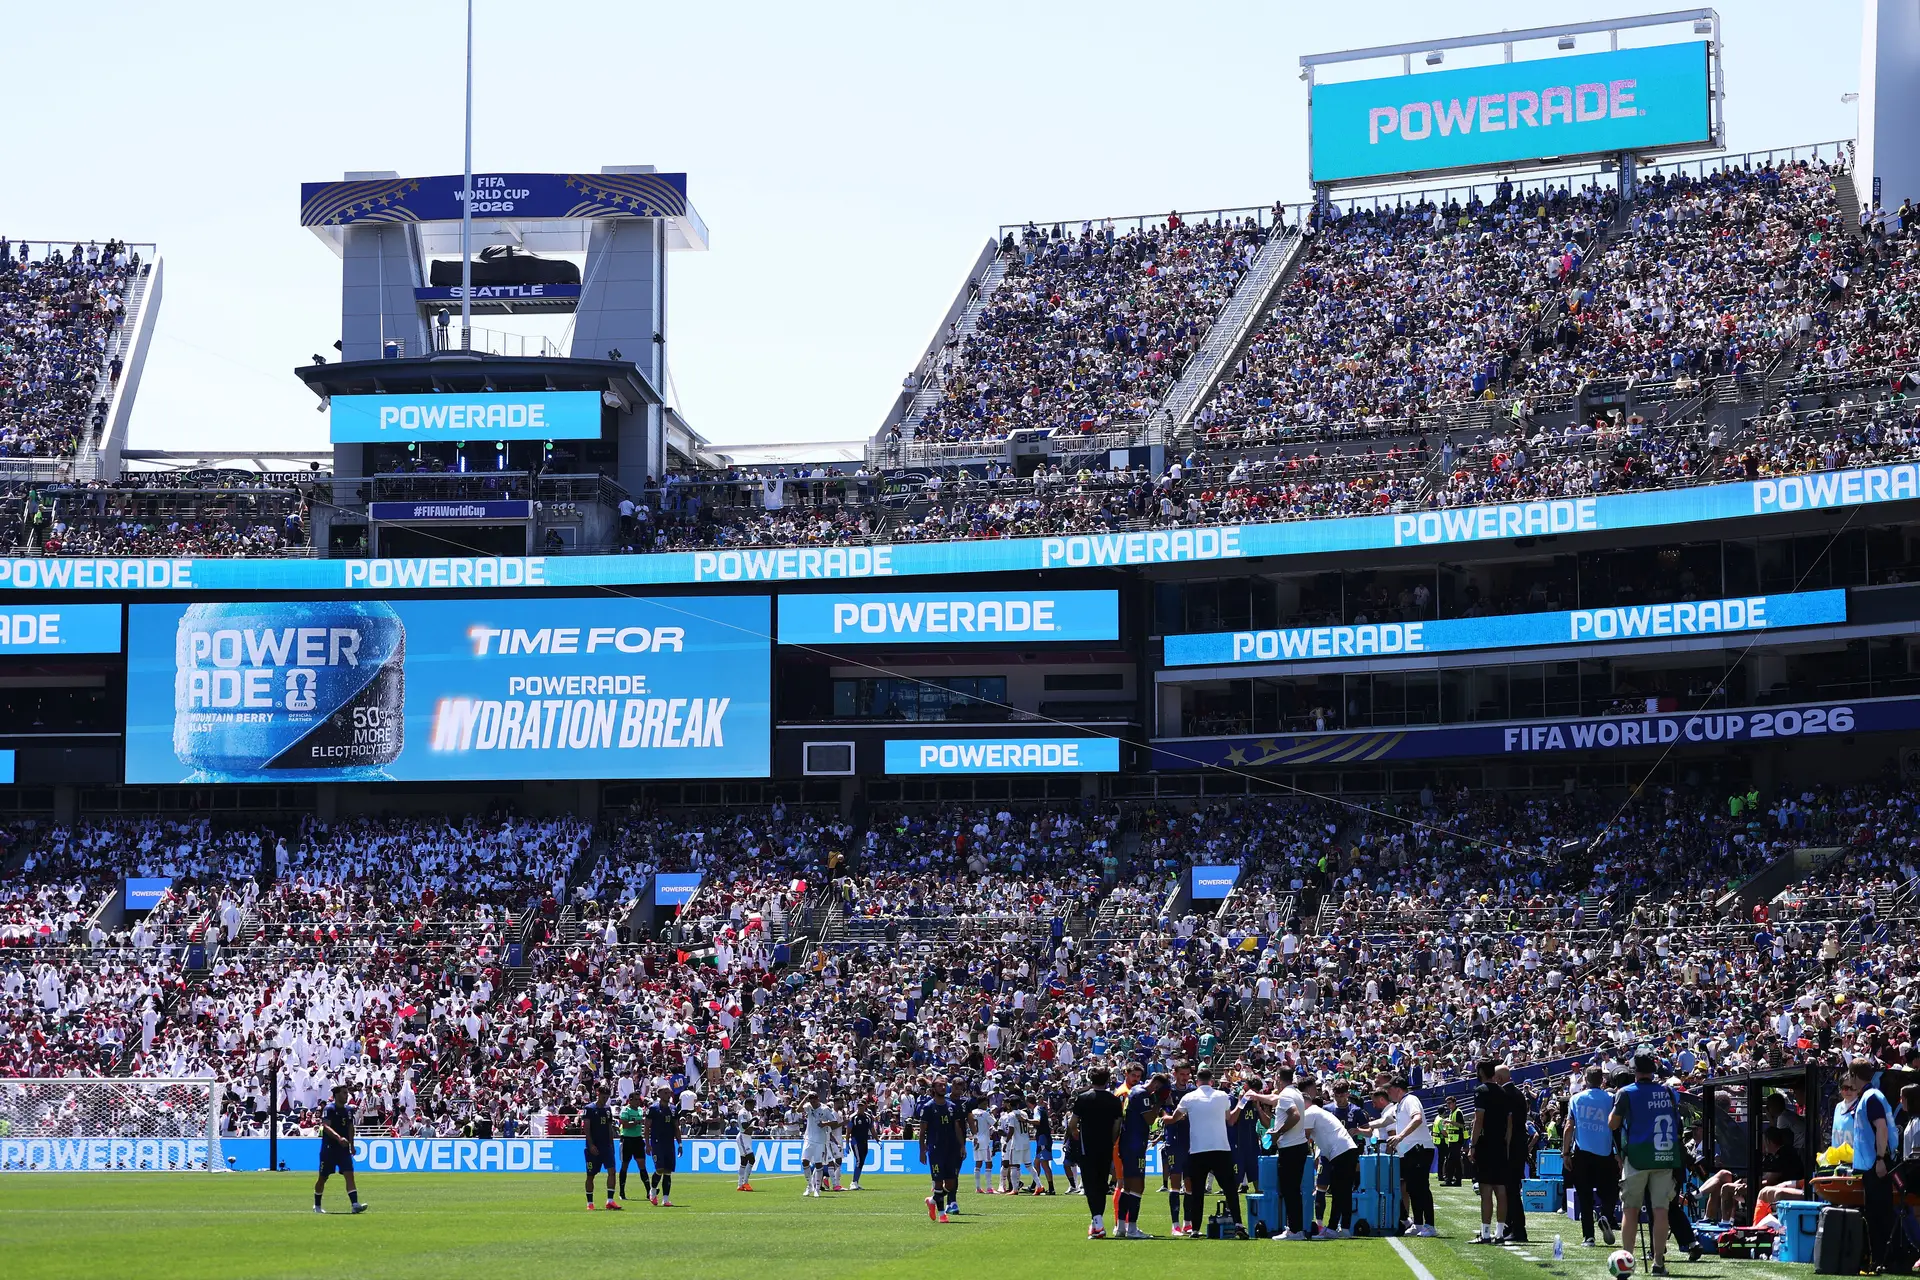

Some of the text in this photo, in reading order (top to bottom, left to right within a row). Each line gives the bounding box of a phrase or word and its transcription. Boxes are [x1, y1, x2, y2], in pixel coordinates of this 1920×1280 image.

[1369, 78, 1637, 144] POWERADE
[478, 177, 506, 188] FIFA
[504, 190, 530, 199] CUP
[470, 202, 514, 212] 2026
[380, 404, 545, 429] POWERADE
[1017, 433, 1048, 444] 32
[1754, 464, 1920, 513] POWERA
[414, 505, 486, 518] #FIFAWorldCup
[1394, 499, 1597, 546] POWERADE
[1042, 527, 1241, 567] POWERADE
[346, 557, 545, 588] POWERADE
[695, 546, 893, 580] POWERADE
[834, 600, 1055, 634] POWERADE
[1571, 598, 1767, 640] POWERADE
[190, 628, 362, 667] POWER
[469, 626, 685, 655] TIME FOR
[1233, 623, 1424, 660] POWERADE
[190, 670, 273, 708] ADE
[509, 676, 646, 695] POWERADE
[236, 713, 274, 723] BERRY
[352, 706, 392, 728] 50%
[431, 698, 730, 751] HYDRATION BREAK
[1504, 707, 1855, 752] FIFA WORLD CUP 2026
[354, 728, 391, 744] MORE
[920, 744, 1079, 768] POWERADE
[941, 1116, 949, 1124] 14
[1244, 1110, 1254, 1120] 24
[1578, 1122, 1604, 1132] CTOR
[2, 1140, 208, 1169] POWERADE
[352, 1140, 553, 1170] POWERADE
[692, 1142, 904, 1172] POWEDE
[932, 1164, 939, 1173] 14
[1168, 1155, 1175, 1165] 21
